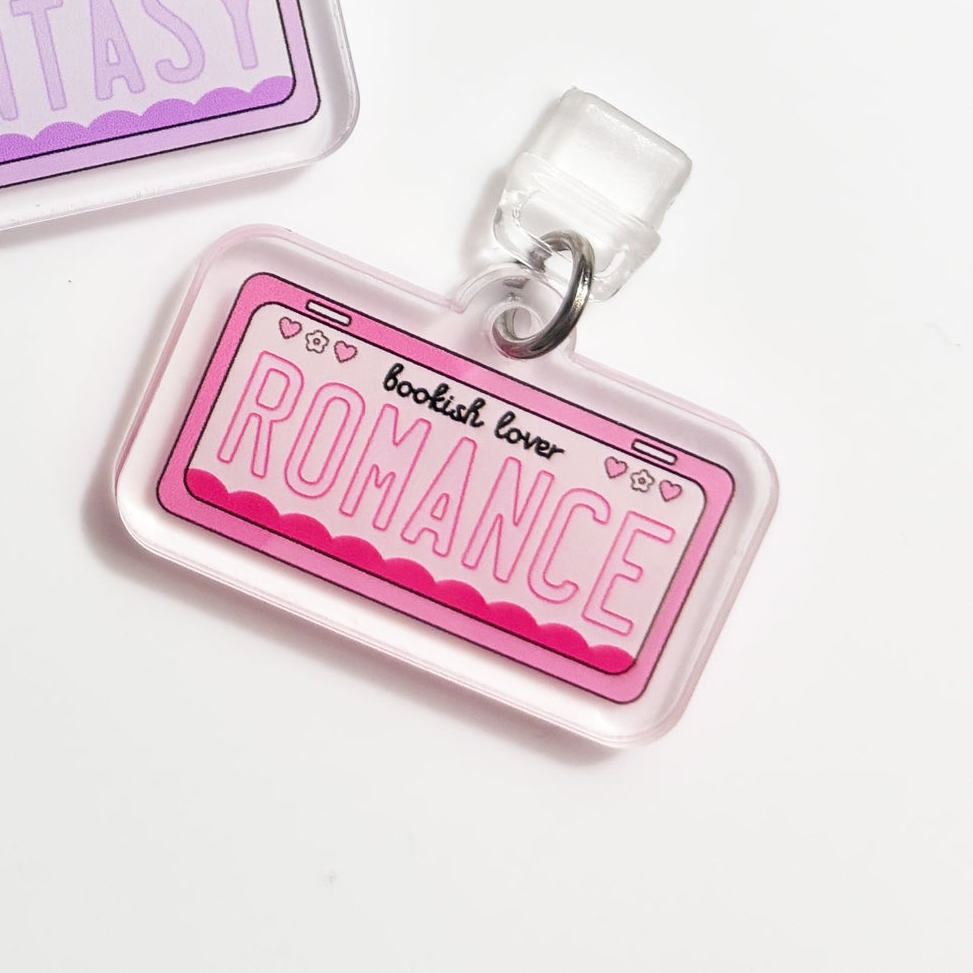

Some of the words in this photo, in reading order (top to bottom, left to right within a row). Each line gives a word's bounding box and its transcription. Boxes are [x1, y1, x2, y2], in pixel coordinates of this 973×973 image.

[216, 350, 675, 637] ROMANCE
[382, 363, 485, 429] bookish
[494, 411, 565, 461] lover
